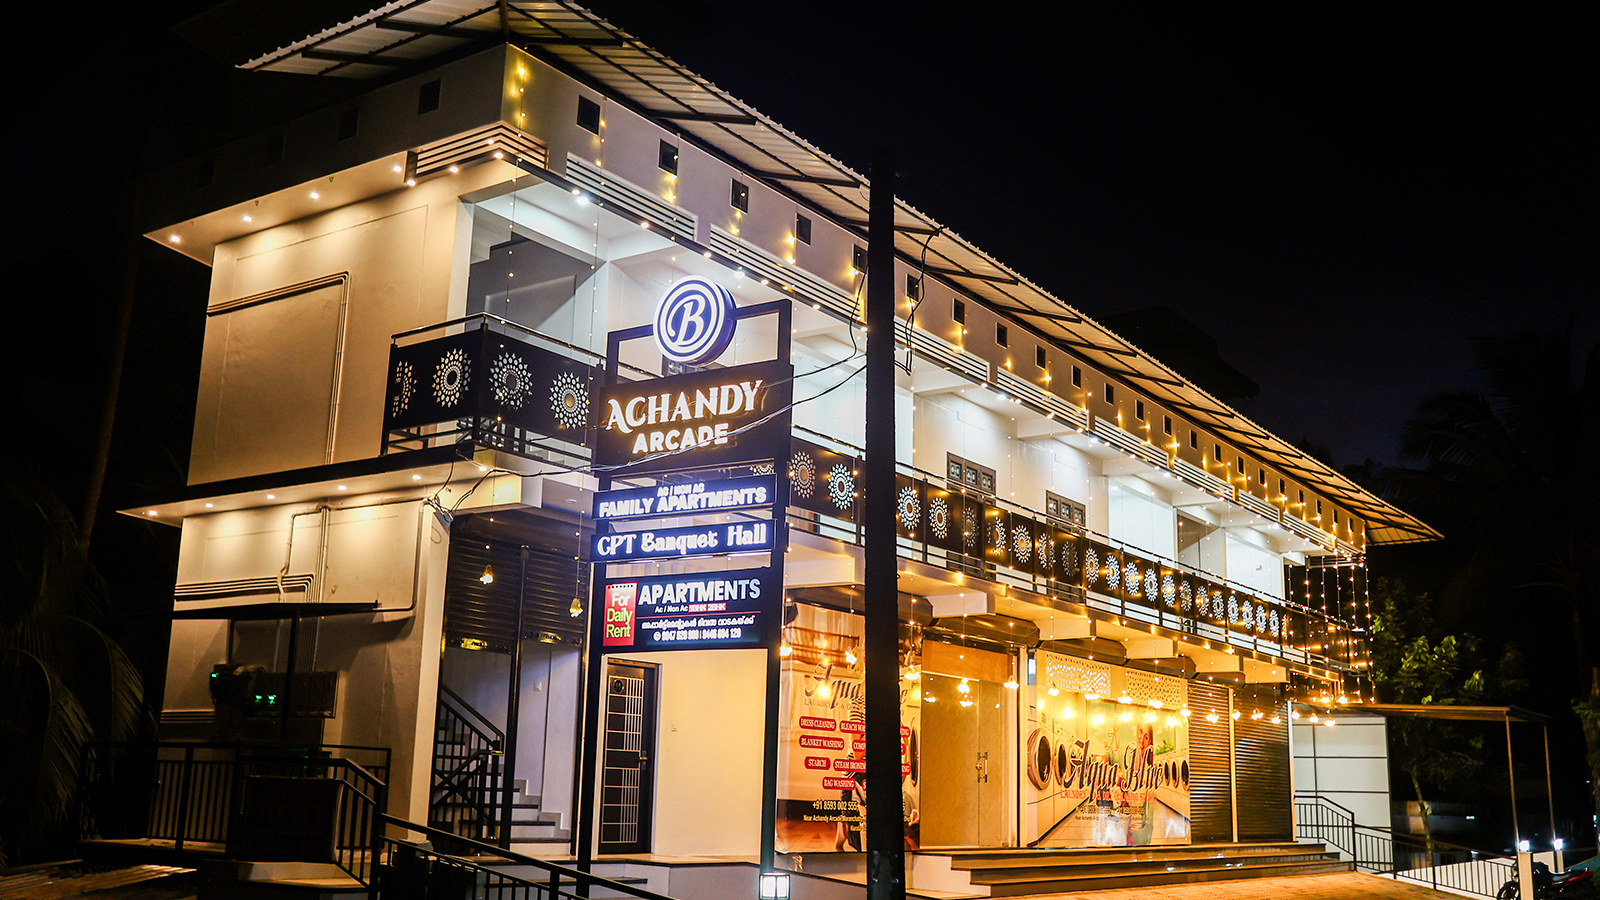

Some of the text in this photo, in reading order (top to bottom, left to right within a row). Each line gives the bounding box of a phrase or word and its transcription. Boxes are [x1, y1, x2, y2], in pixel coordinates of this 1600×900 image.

[605, 379, 764, 434] ACHANDY
[632, 422, 729, 455] ARCADE
[657, 486, 669, 498] AC
[674, 484, 691, 496] NON
[692, 482, 705, 494] AC
[599, 487, 767, 518] FAMILY APARTMENTS
[597, 523, 767, 555] CPT Banquet Hall
[638, 578, 761, 605] APARTMENTS
[611, 593, 631, 607] For
[607, 608, 633, 625] Daily
[606, 625, 631, 638] Rent
[801, 738, 843, 749] BLANKET WASHING
[808, 758, 827, 768] STARCH
[1063, 739, 1119, 803] Aqua
[823, 779, 854, 788] BAG WASHING
[812, 800, 822, 810] +91
[823, 800, 836, 810] 8593
